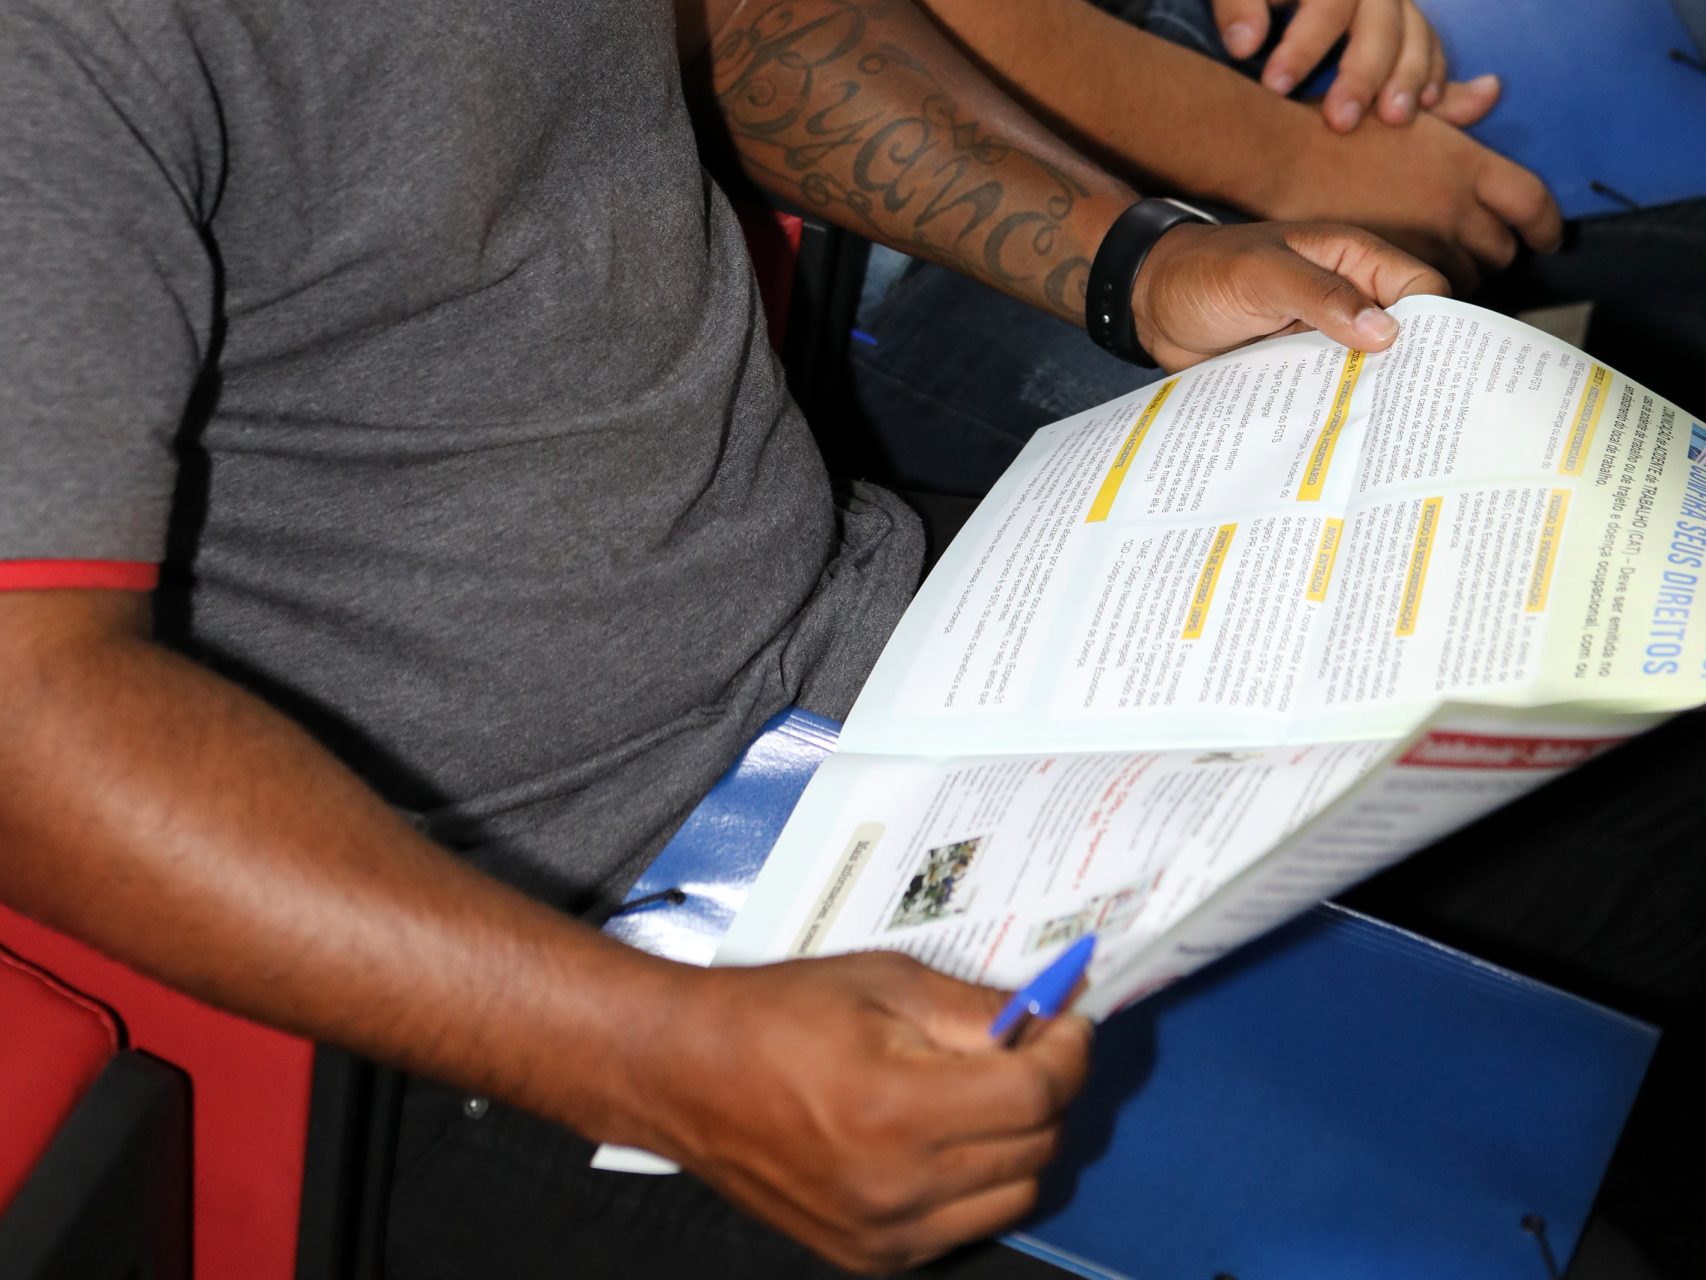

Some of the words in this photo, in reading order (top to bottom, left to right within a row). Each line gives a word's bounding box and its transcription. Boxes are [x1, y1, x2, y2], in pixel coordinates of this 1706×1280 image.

[1271, 422, 1285, 444] FGTS
[1608, 428, 1625, 445] local
[1613, 420, 1628, 430] do
[1634, 429, 1647, 439] de
[1605, 443, 1620, 455] de
[1627, 437, 1646, 463] trabalho
[1647, 443, 1667, 475] ACIDENTE
[1620, 473, 1635, 485] de
[1623, 462, 1636, 473] ou
[1645, 473, 1659, 484] de
[1608, 483, 1632, 513] trajeto
[1631, 483, 1657, 529] TRABALHO
[1609, 512, 1620, 520] e
[1322, 526, 1336, 551] NOVA
[1596, 520, 1621, 559] doença
[1622, 527, 1645, 556] (CAT)
[1667, 519, 1706, 569] SEUS
[1311, 552, 1329, 594] ENTRADA
[1614, 564, 1635, 594] Deve
[1610, 594, 1625, 613] ser
[1641, 569, 1698, 680] DIREITOS
[1577, 632, 1593, 660] com
[1574, 661, 1587, 679] ou
